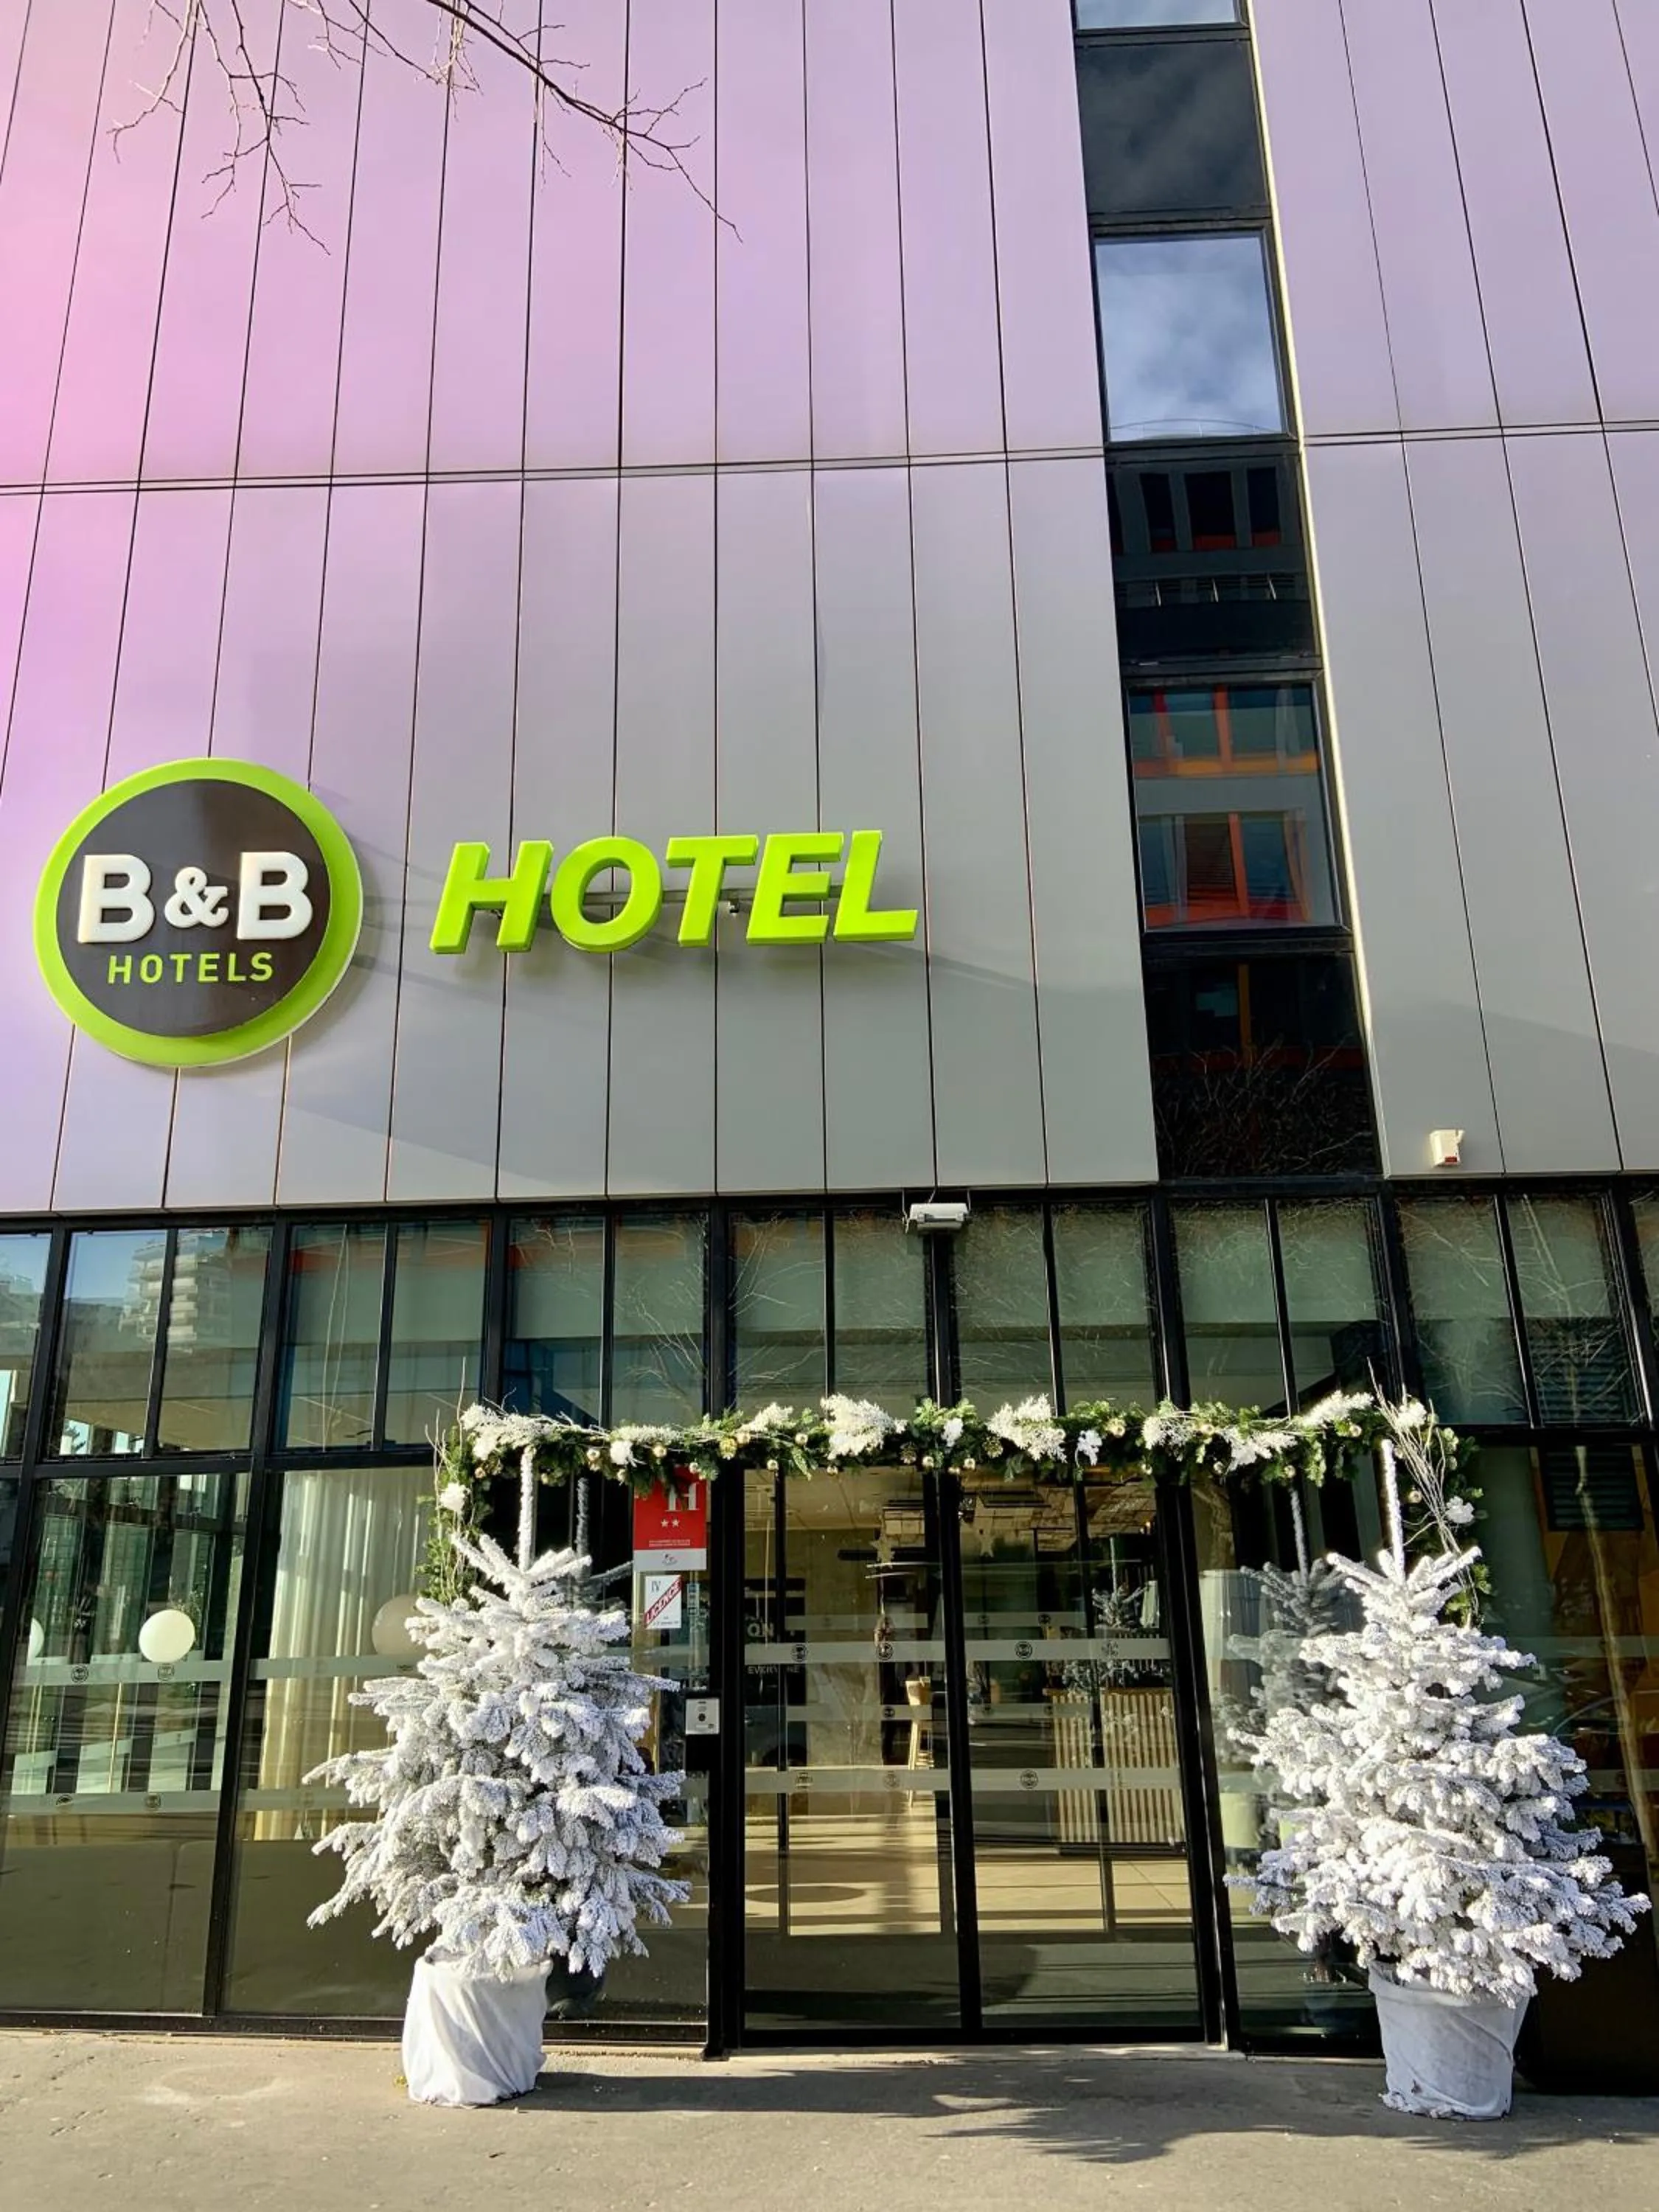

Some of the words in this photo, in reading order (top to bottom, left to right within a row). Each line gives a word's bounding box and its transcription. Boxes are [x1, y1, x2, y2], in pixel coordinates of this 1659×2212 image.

[77, 852, 313, 943] B&B
[429, 830, 918, 954] HOTEL
[108, 953, 274, 984] HOTELS
